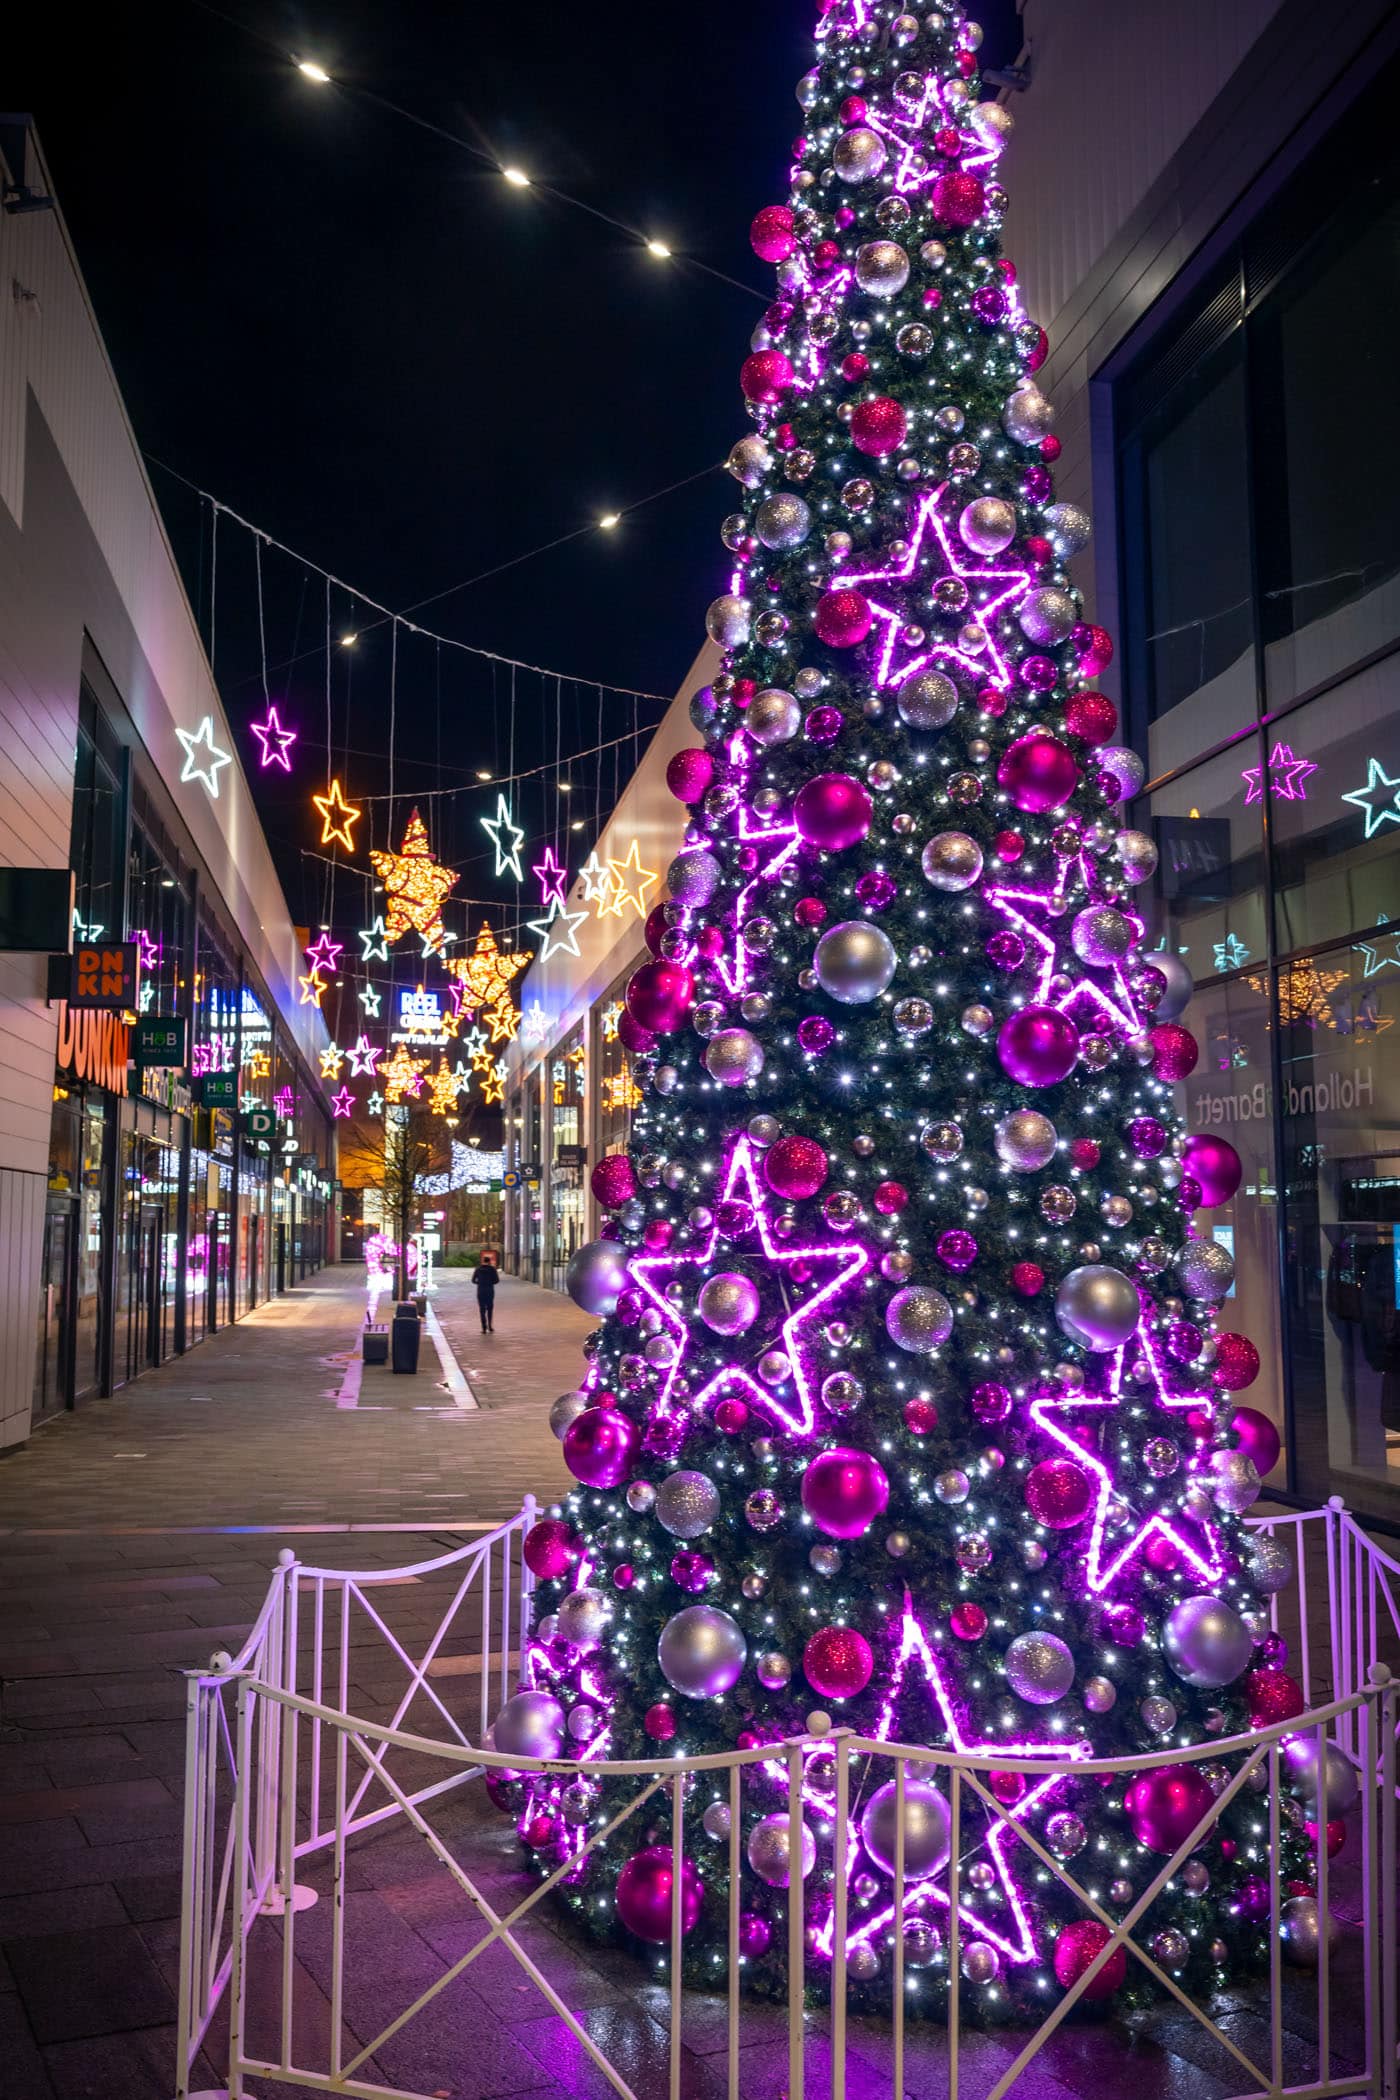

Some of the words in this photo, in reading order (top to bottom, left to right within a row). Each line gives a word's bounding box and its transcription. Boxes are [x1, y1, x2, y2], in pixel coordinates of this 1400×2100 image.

[78, 950, 123, 973] DN
[252, 1114, 271, 1132] D
[281, 1140, 299, 1152] JD
